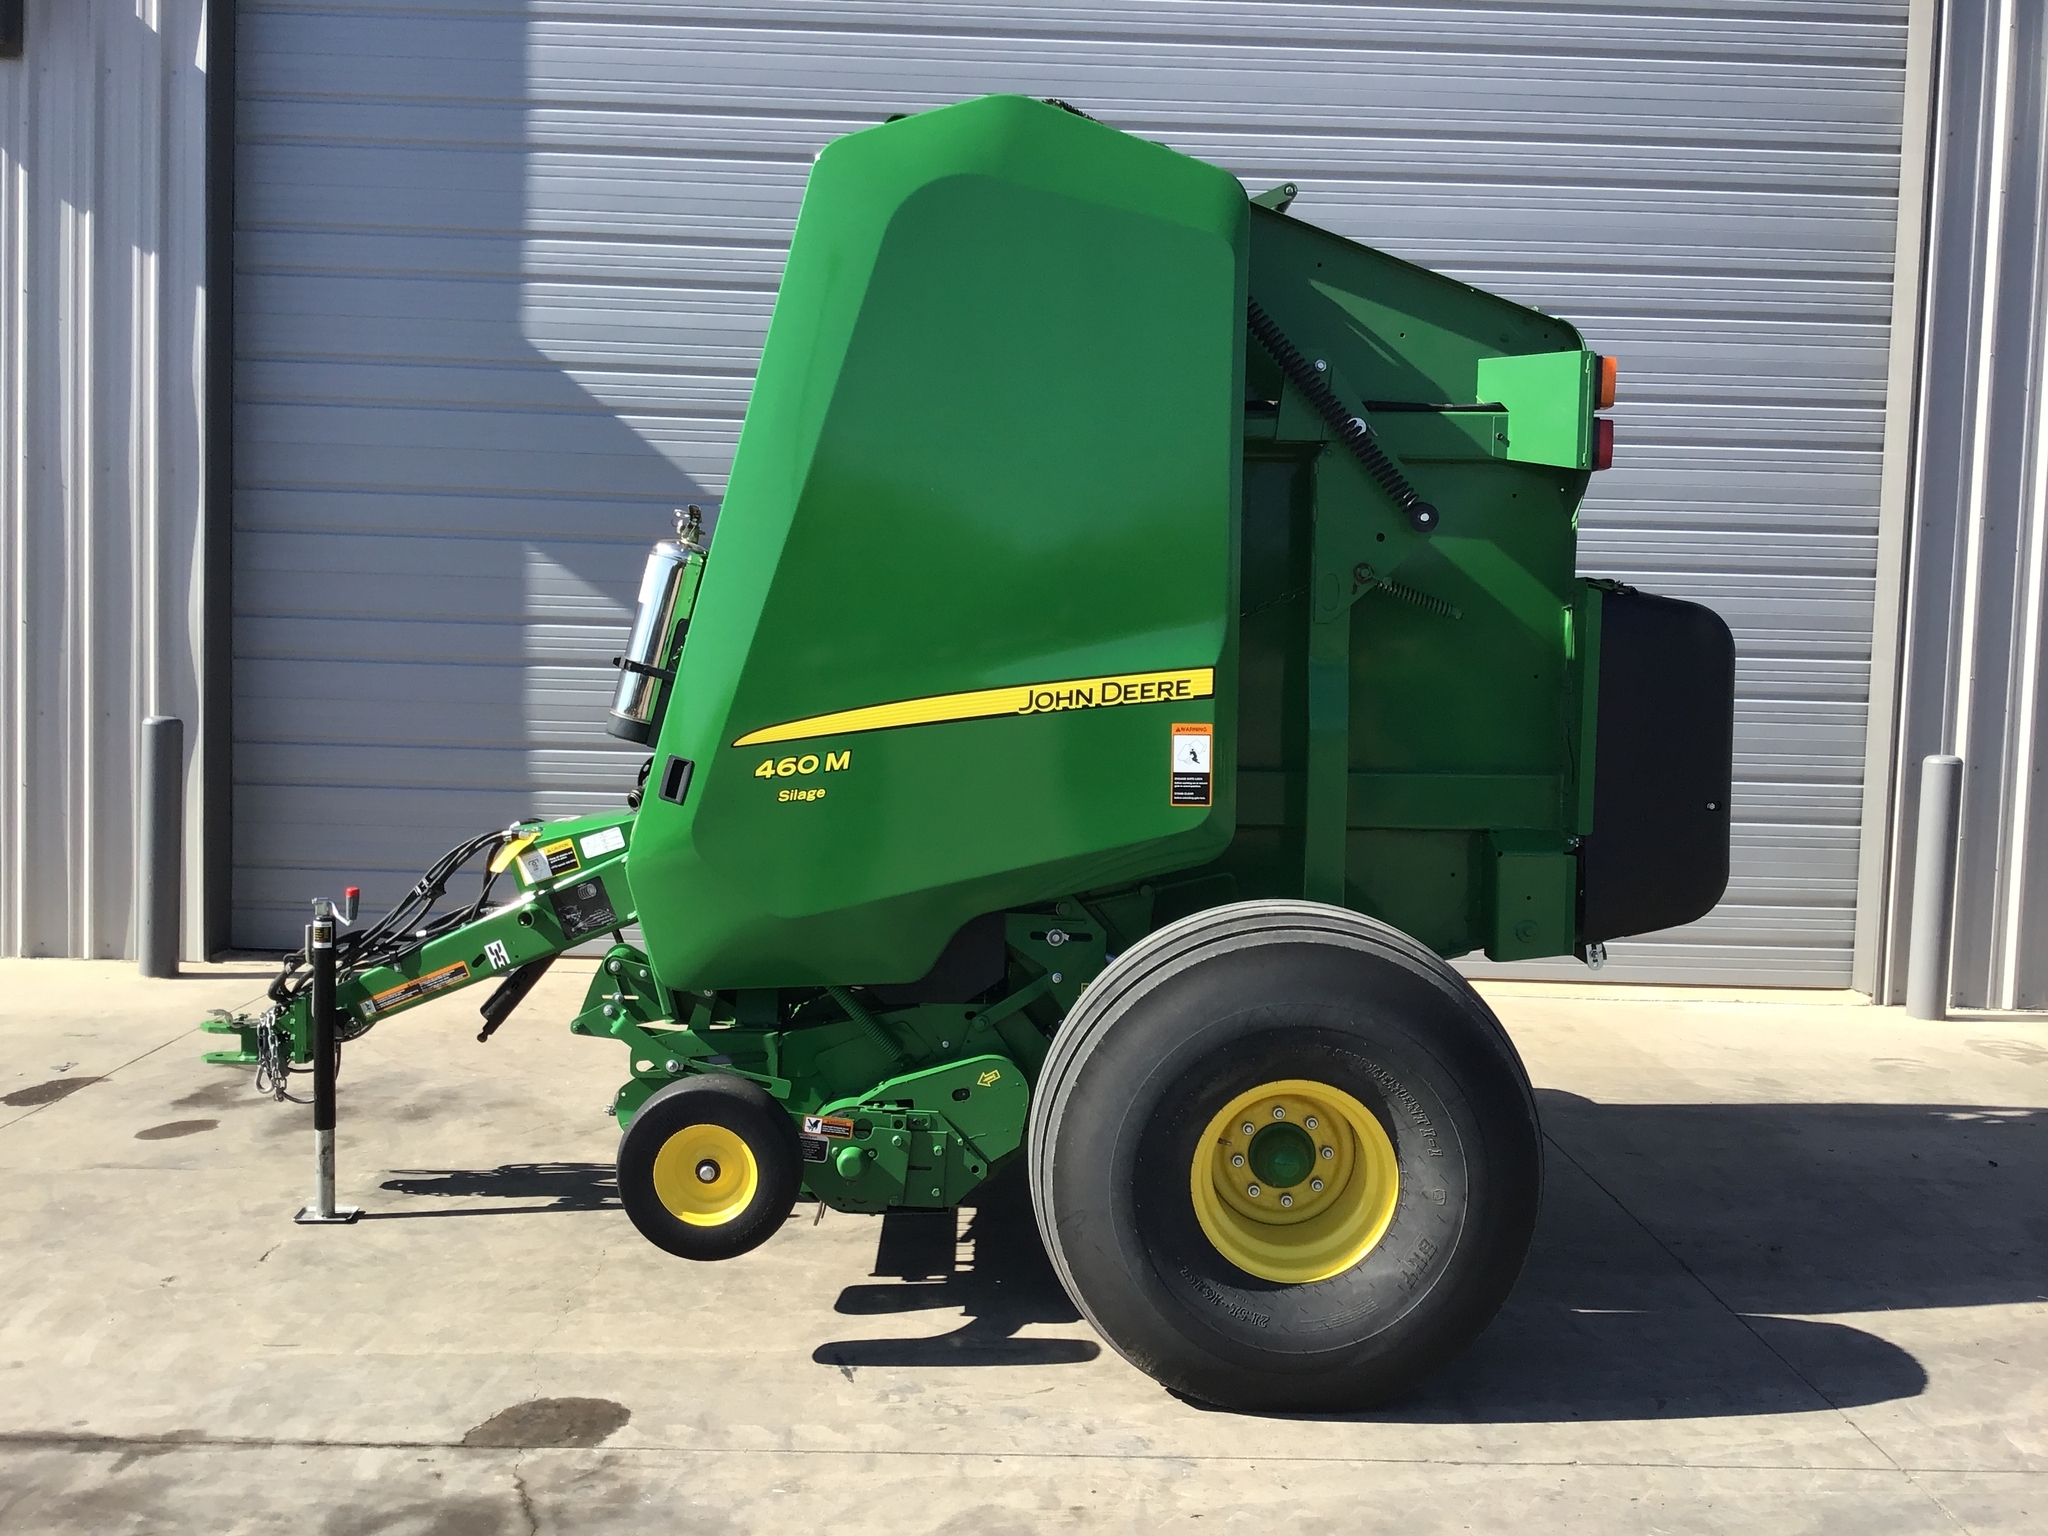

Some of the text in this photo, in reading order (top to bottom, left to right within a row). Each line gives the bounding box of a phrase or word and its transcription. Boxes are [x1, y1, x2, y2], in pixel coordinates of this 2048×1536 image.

[1018, 679, 1192, 713] JOHN DEERE
[754, 749, 852, 779] 460 M
[777, 788, 827, 803] Silage
